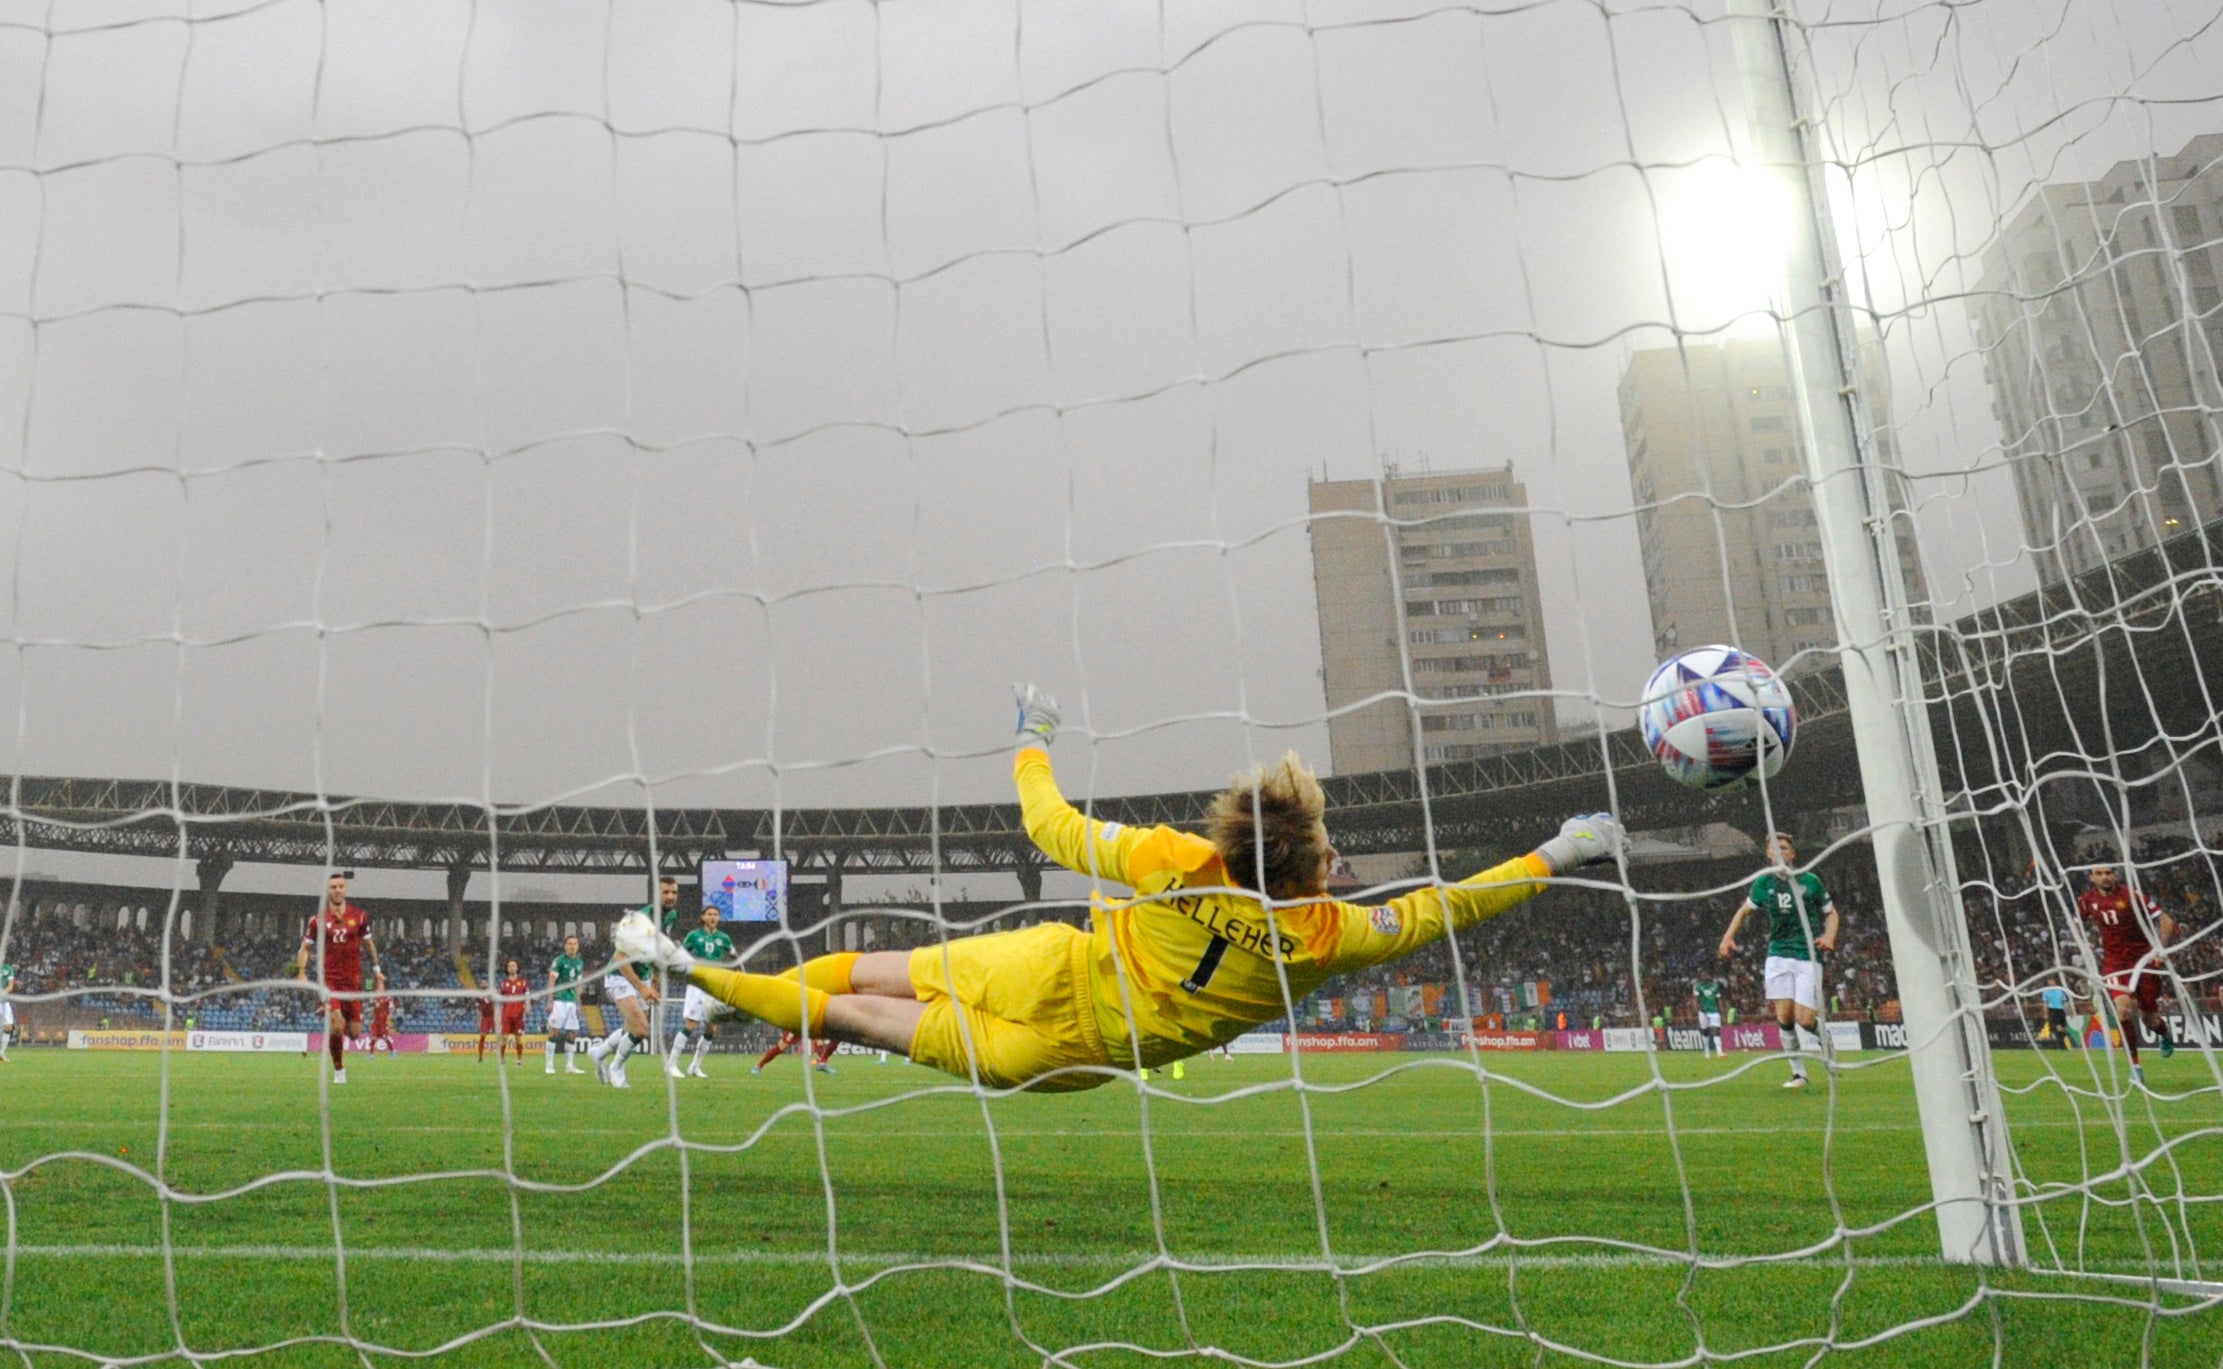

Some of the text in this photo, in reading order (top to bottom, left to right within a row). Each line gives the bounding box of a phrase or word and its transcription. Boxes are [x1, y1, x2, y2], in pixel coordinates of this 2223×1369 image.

[1777, 892, 1793, 909] 12
[1163, 877, 1295, 960] KELLEHER
[332, 928, 348, 943] 22
[704, 941, 715, 954] 13
[1180, 932, 1231, 995] 1
[1286, 1035, 1379, 1048] fnshop.ffa.am
[1461, 1034, 1536, 1048] fnshop.ffa.am
[1667, 1027, 1704, 1050] team
[1741, 1029, 1766, 1048] vbet
